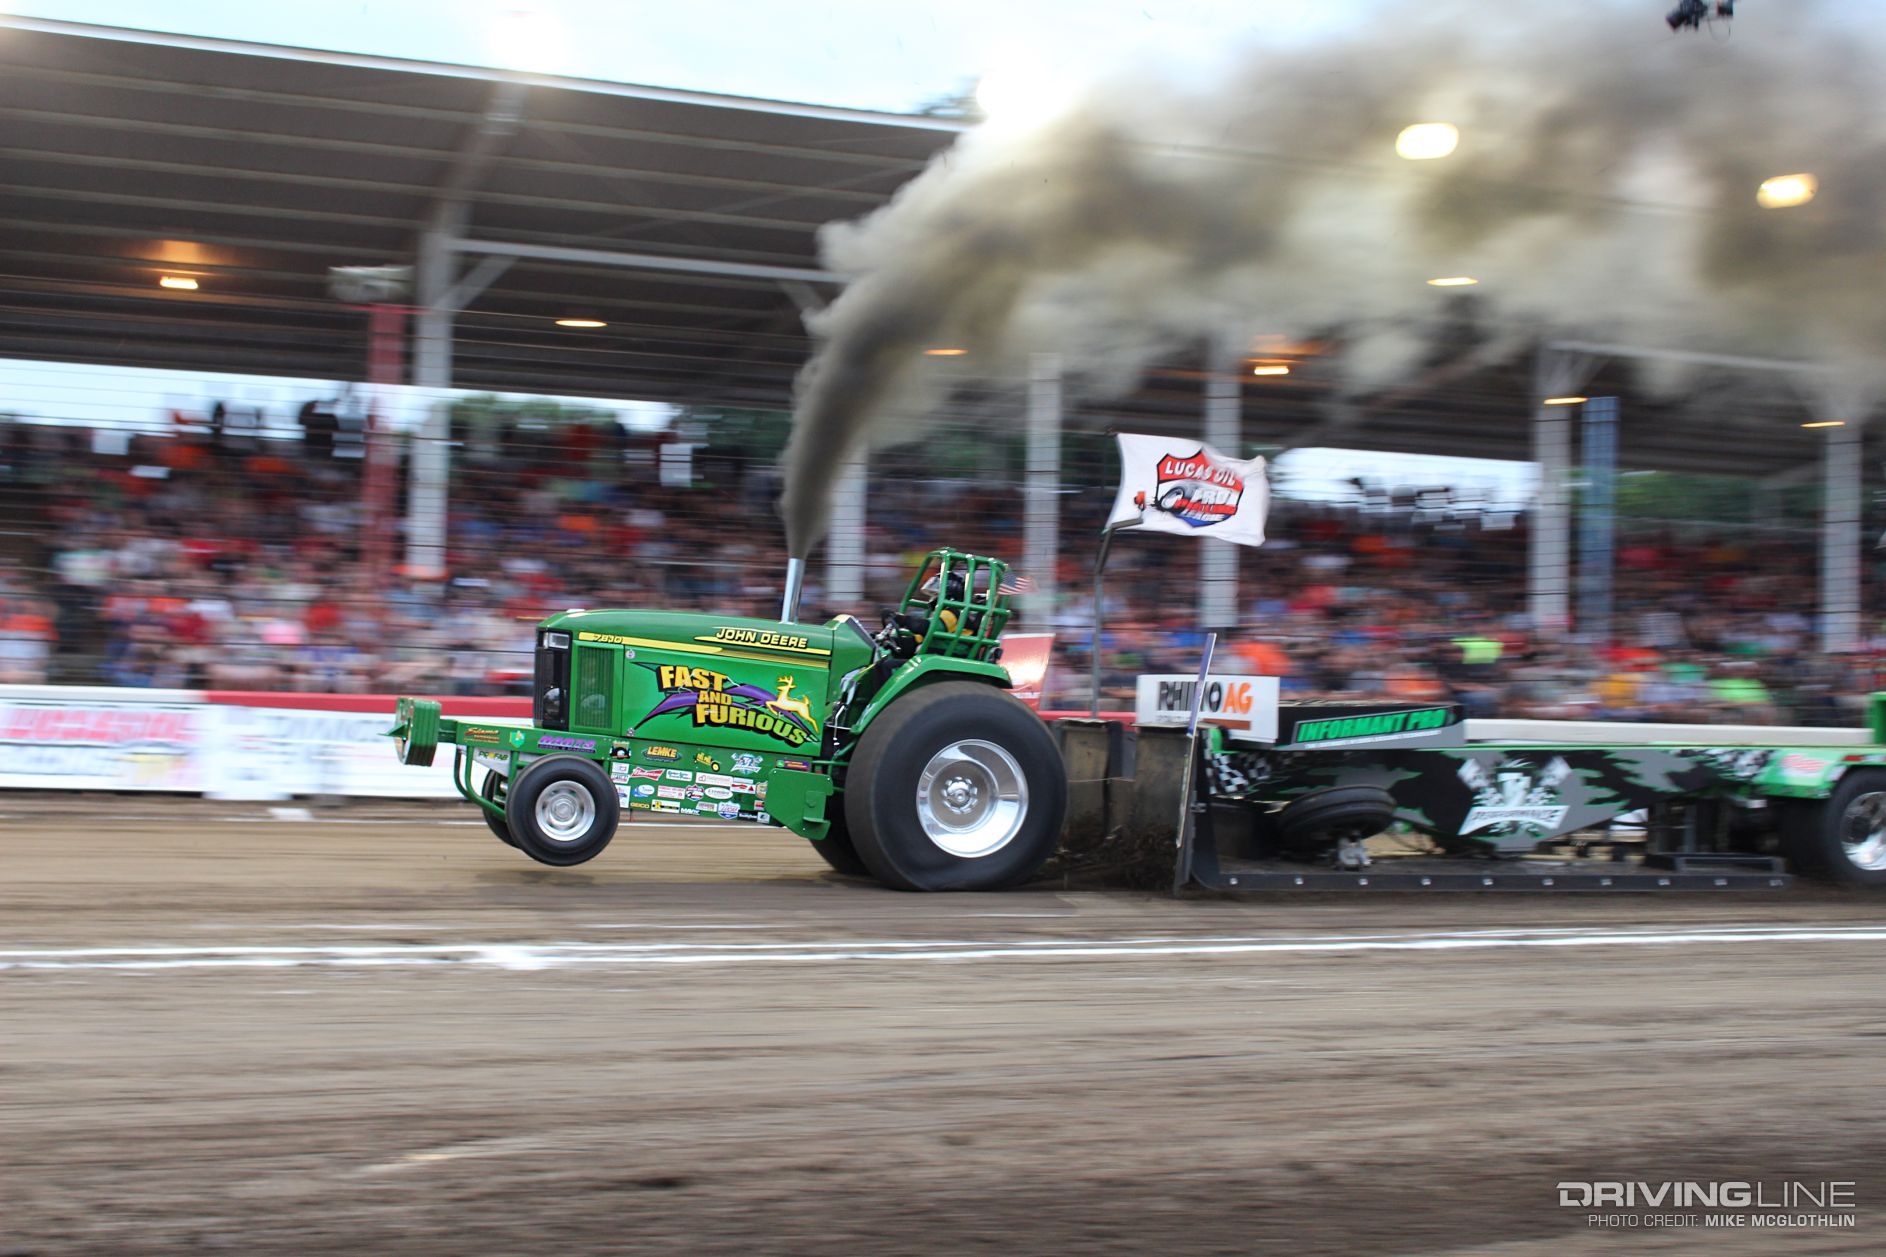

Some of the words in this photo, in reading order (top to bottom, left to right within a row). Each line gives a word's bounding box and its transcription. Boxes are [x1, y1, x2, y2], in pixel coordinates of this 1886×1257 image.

[1165, 460, 1214, 481] LUCAS
[1214, 469, 1236, 486] OIL
[716, 628, 756, 643] JOHN
[760, 632, 808, 648] DEERE
[659, 665, 728, 692] FAST
[697, 690, 733, 706] AND
[695, 703, 808, 745] FURIOUS
[1297, 713, 1409, 742] INFORMANT
[1407, 708, 1448, 731] PRO
[647, 746, 678, 758] LEMKE
